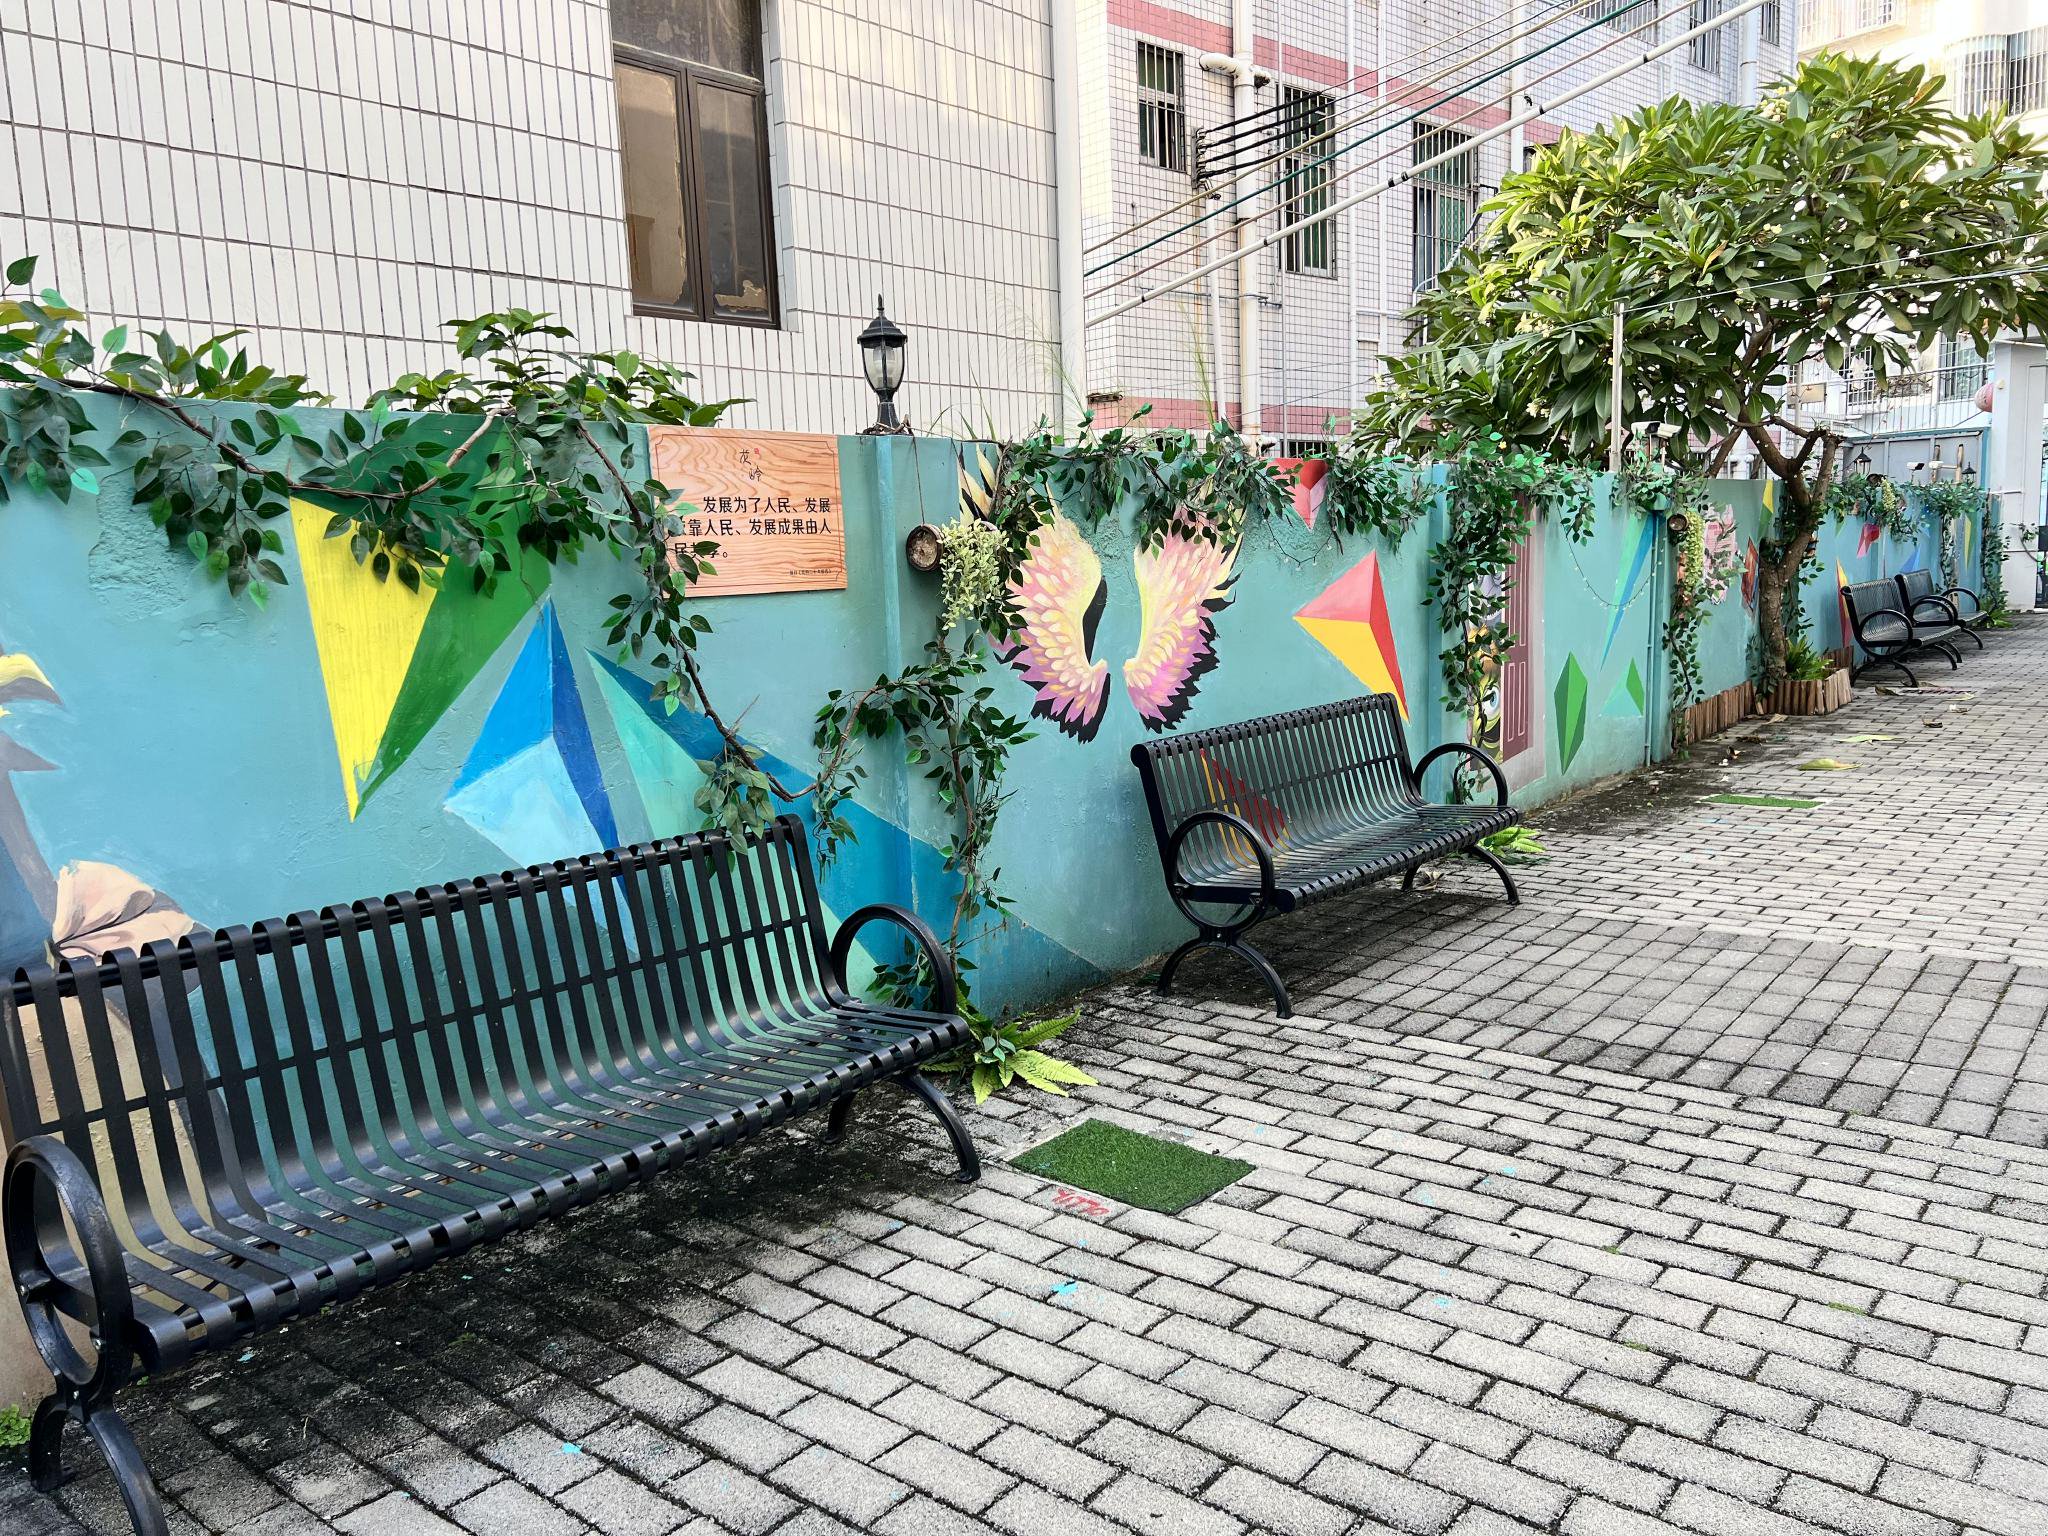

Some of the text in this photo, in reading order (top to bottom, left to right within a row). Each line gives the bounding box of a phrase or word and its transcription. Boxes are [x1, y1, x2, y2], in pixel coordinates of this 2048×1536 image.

[703, 496, 832, 514] 发展为了人民、发展
[683, 518, 832, 536] 靠人民、发展成果由人
